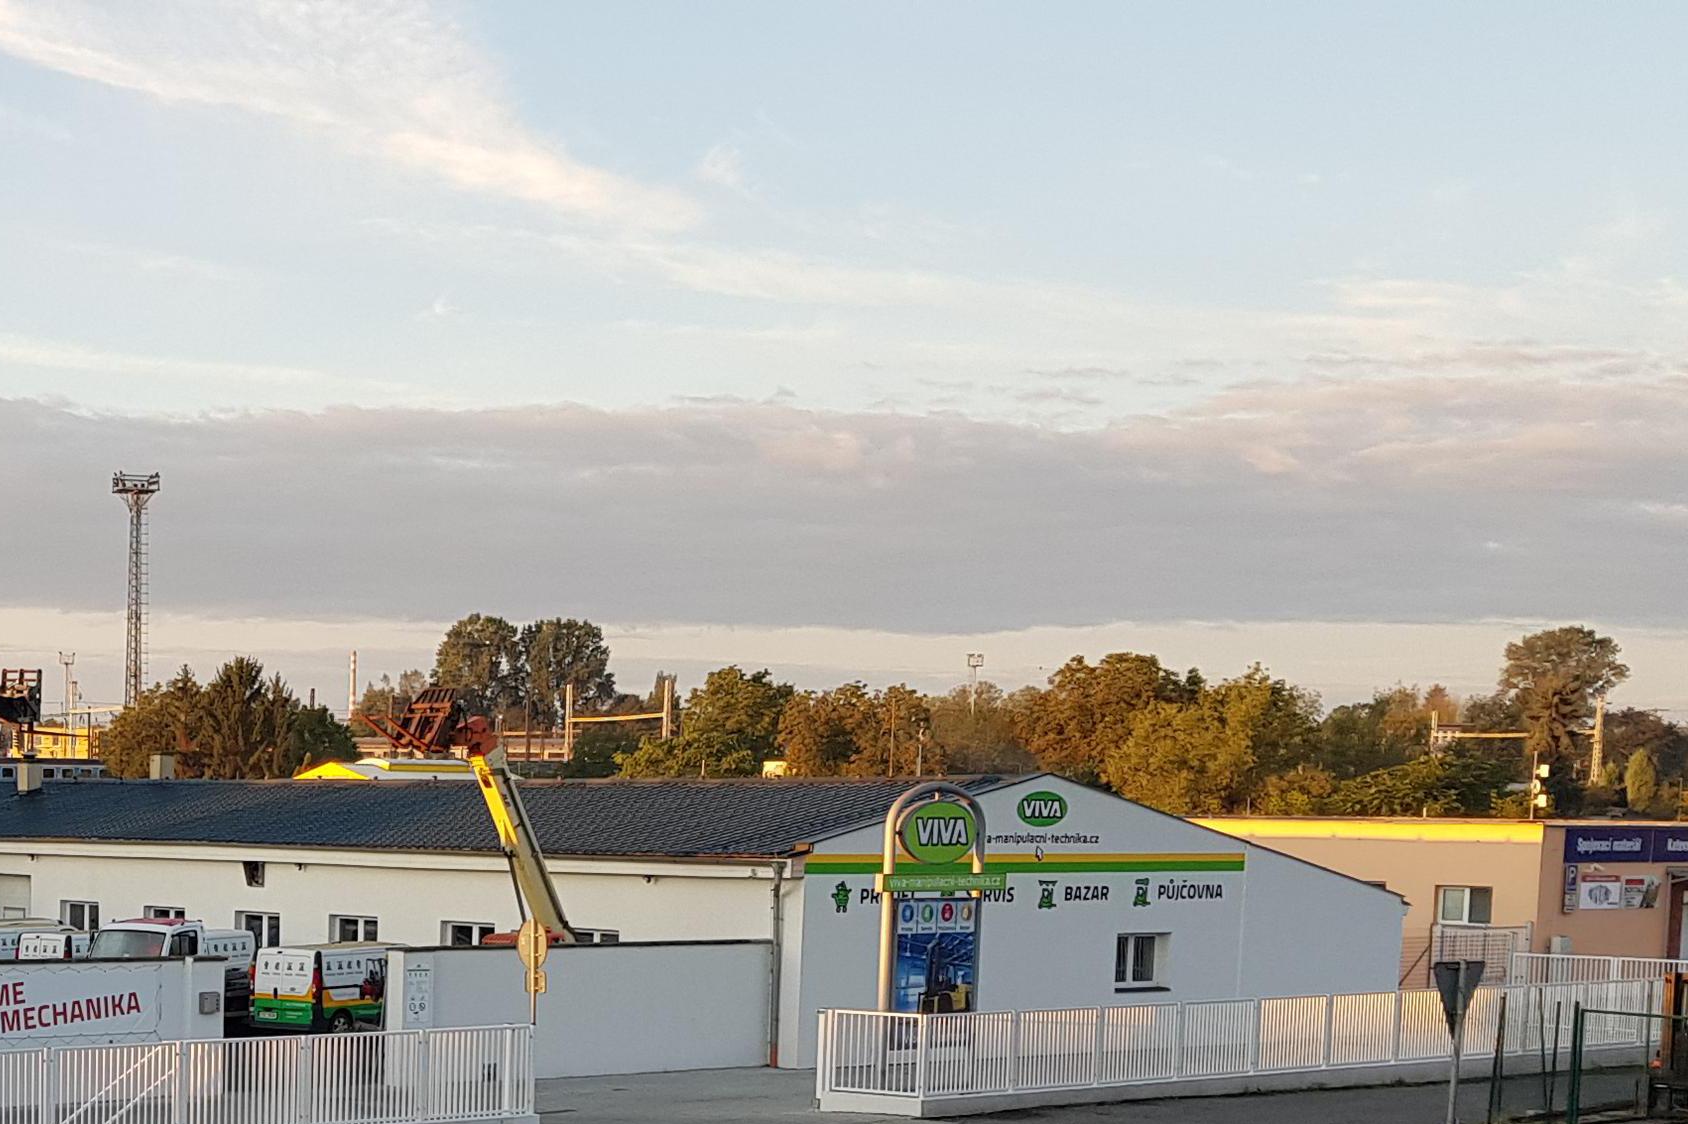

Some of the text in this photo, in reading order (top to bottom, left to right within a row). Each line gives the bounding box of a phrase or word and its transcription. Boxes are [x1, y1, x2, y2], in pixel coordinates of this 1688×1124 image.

[1022, 798, 1063, 819] VIVA
[916, 816, 969, 847] VIVA
[1064, 885, 1110, 901] BAZAR
[1157, 878, 1223, 901] PŮJČOVNA
[0, 992, 141, 1034] MECHANIKA
